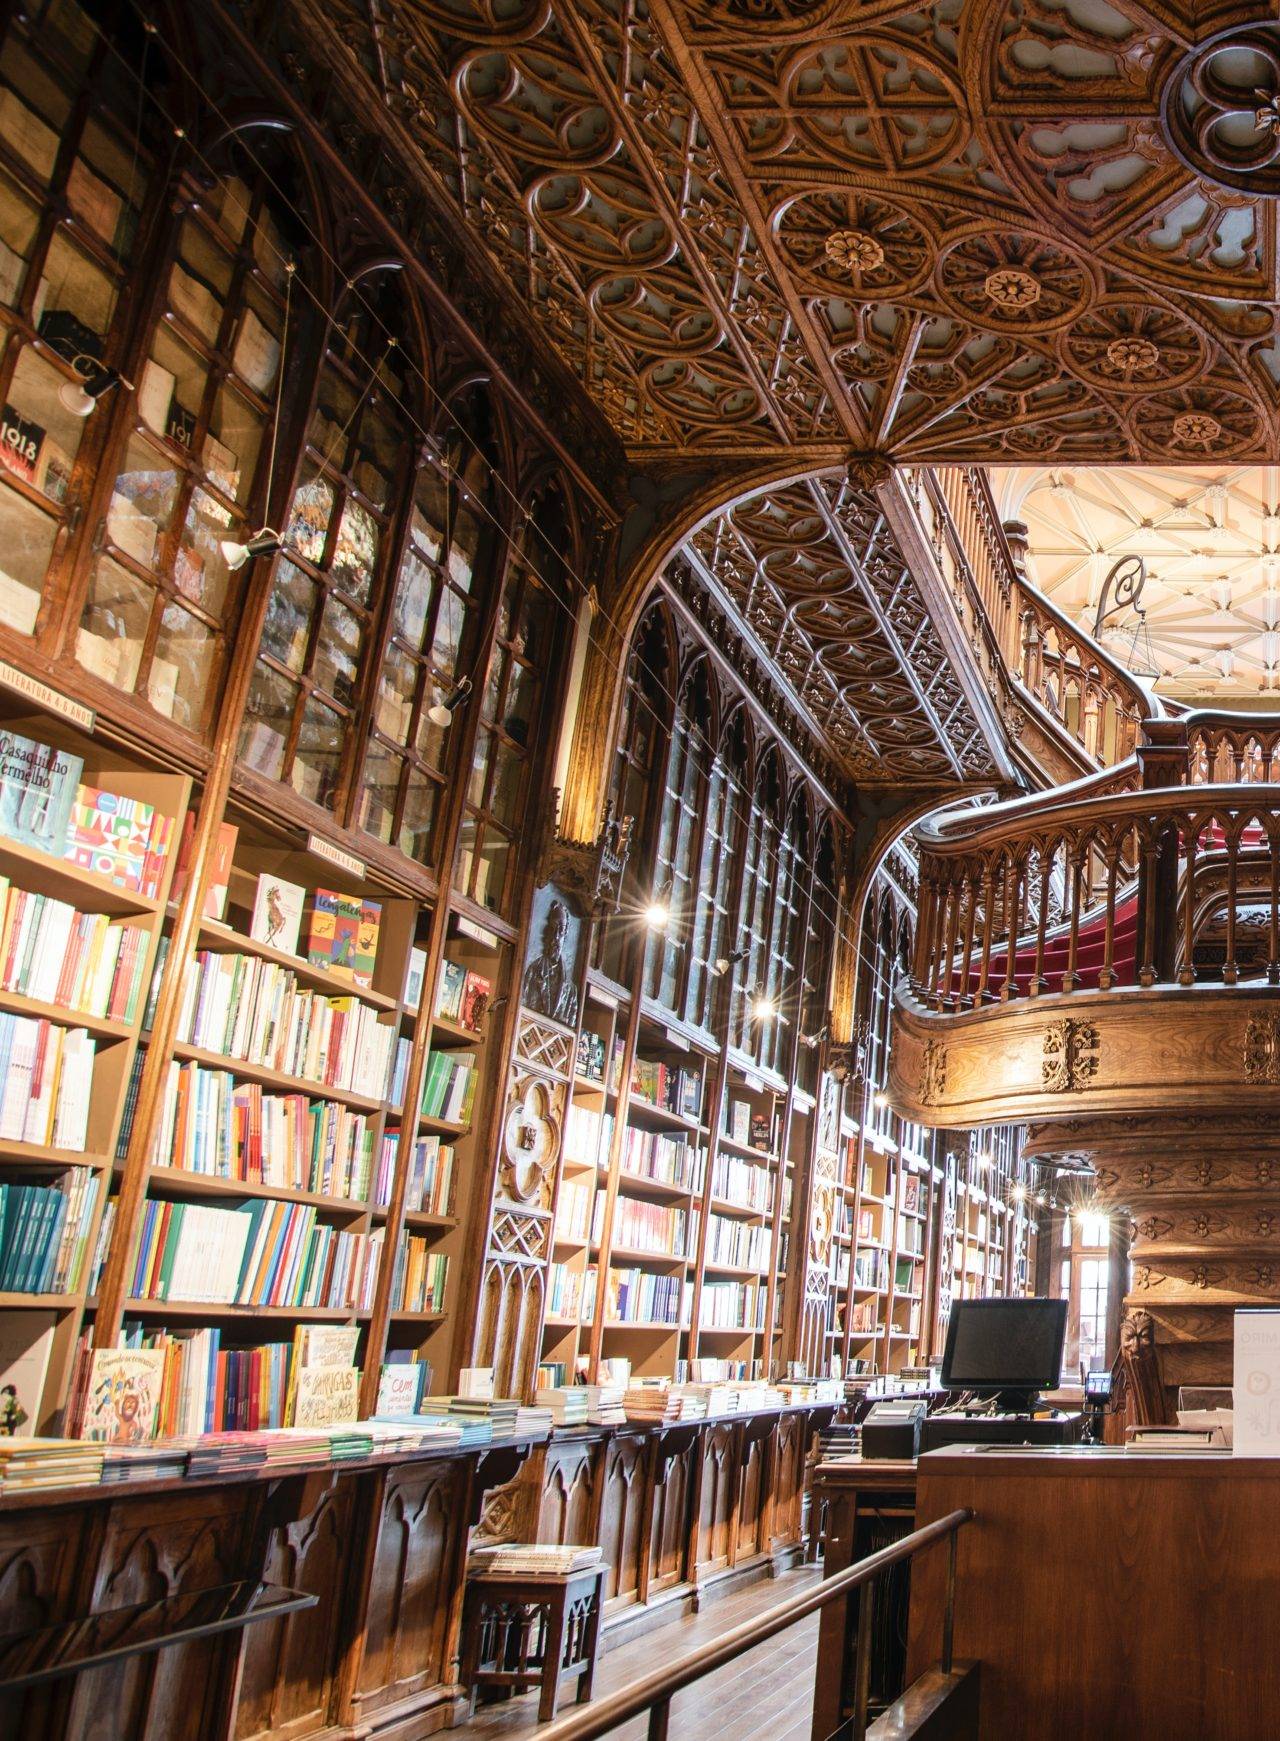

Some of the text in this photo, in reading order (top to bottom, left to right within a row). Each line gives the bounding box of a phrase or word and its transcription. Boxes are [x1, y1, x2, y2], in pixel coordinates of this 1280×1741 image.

[1, 421, 37, 461] 1918
[172, 420, 191, 448] 191
[2, 666, 52, 703] LITERATURA
[70, 706, 91, 725] ANOS
